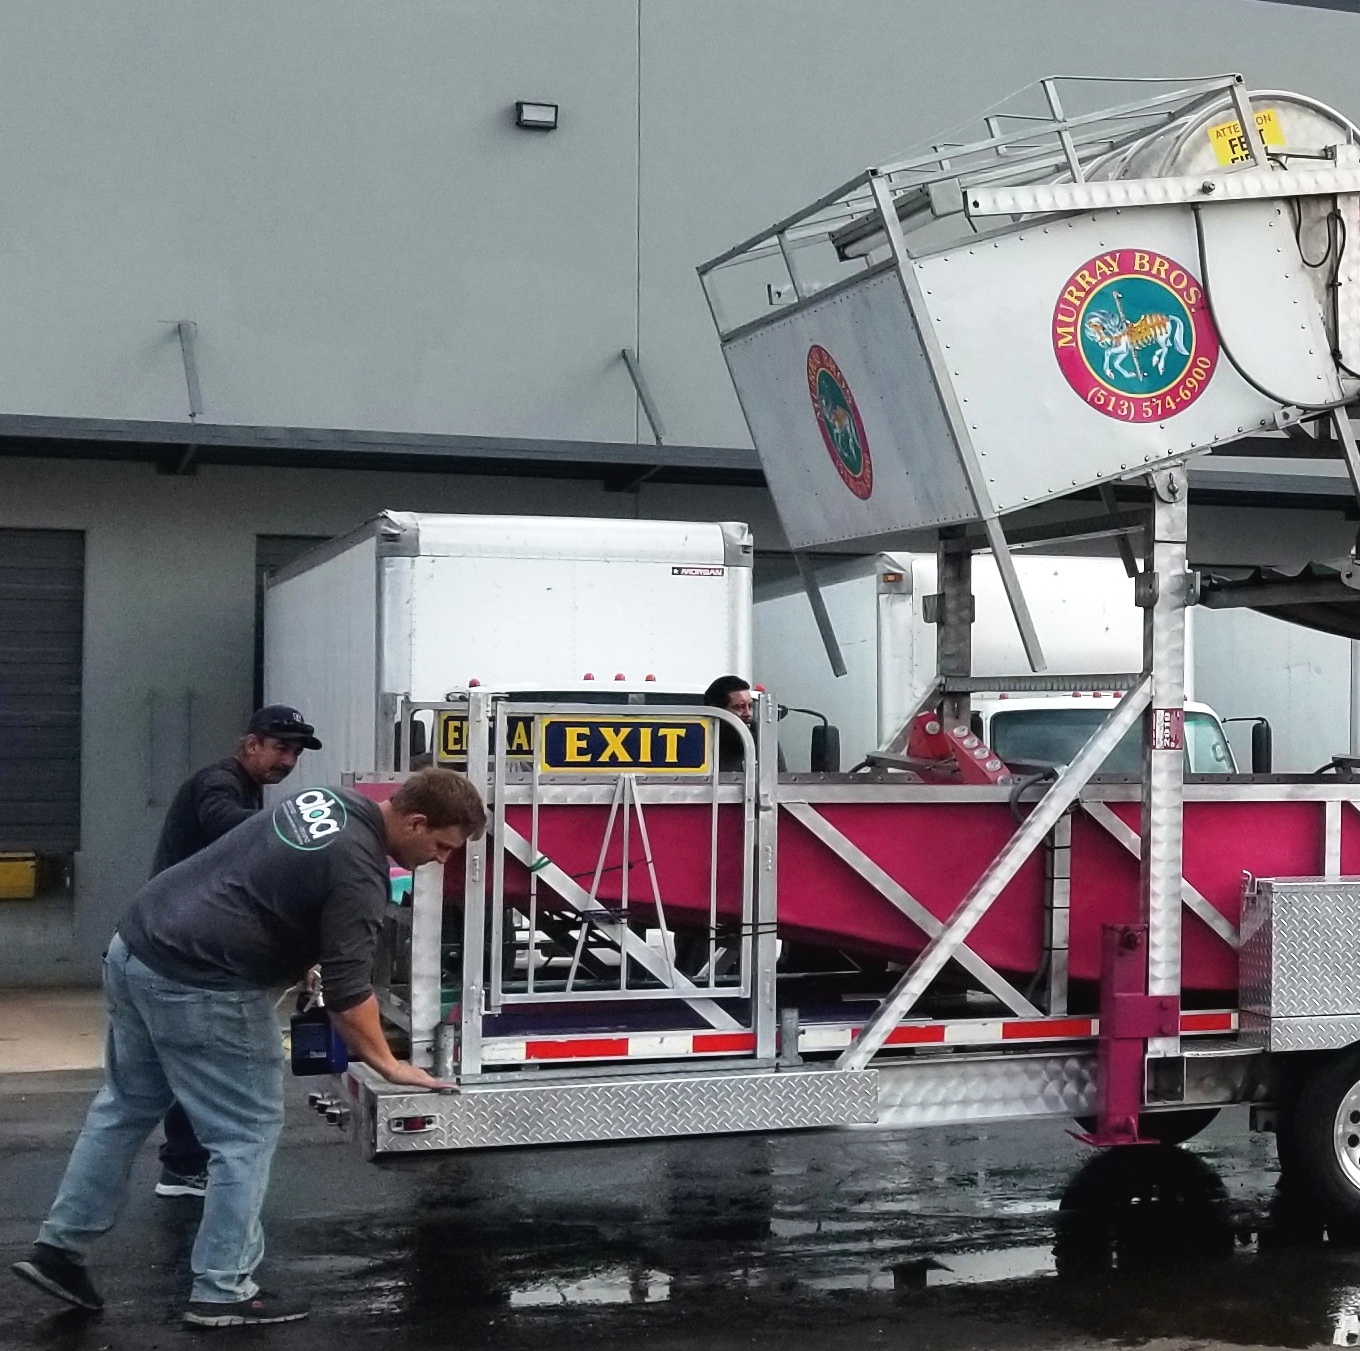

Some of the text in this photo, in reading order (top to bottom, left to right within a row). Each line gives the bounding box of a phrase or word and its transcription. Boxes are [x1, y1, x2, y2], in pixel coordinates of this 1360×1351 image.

[1215, 114, 1272, 139] ATTEON
[1228, 129, 1265, 154] FET
[1056, 252, 1202, 348] MURRAY BROS.
[1087, 357, 1211, 420] (513) 574-6900
[564, 727, 686, 763] EXIT
[296, 791, 340, 839] aba
